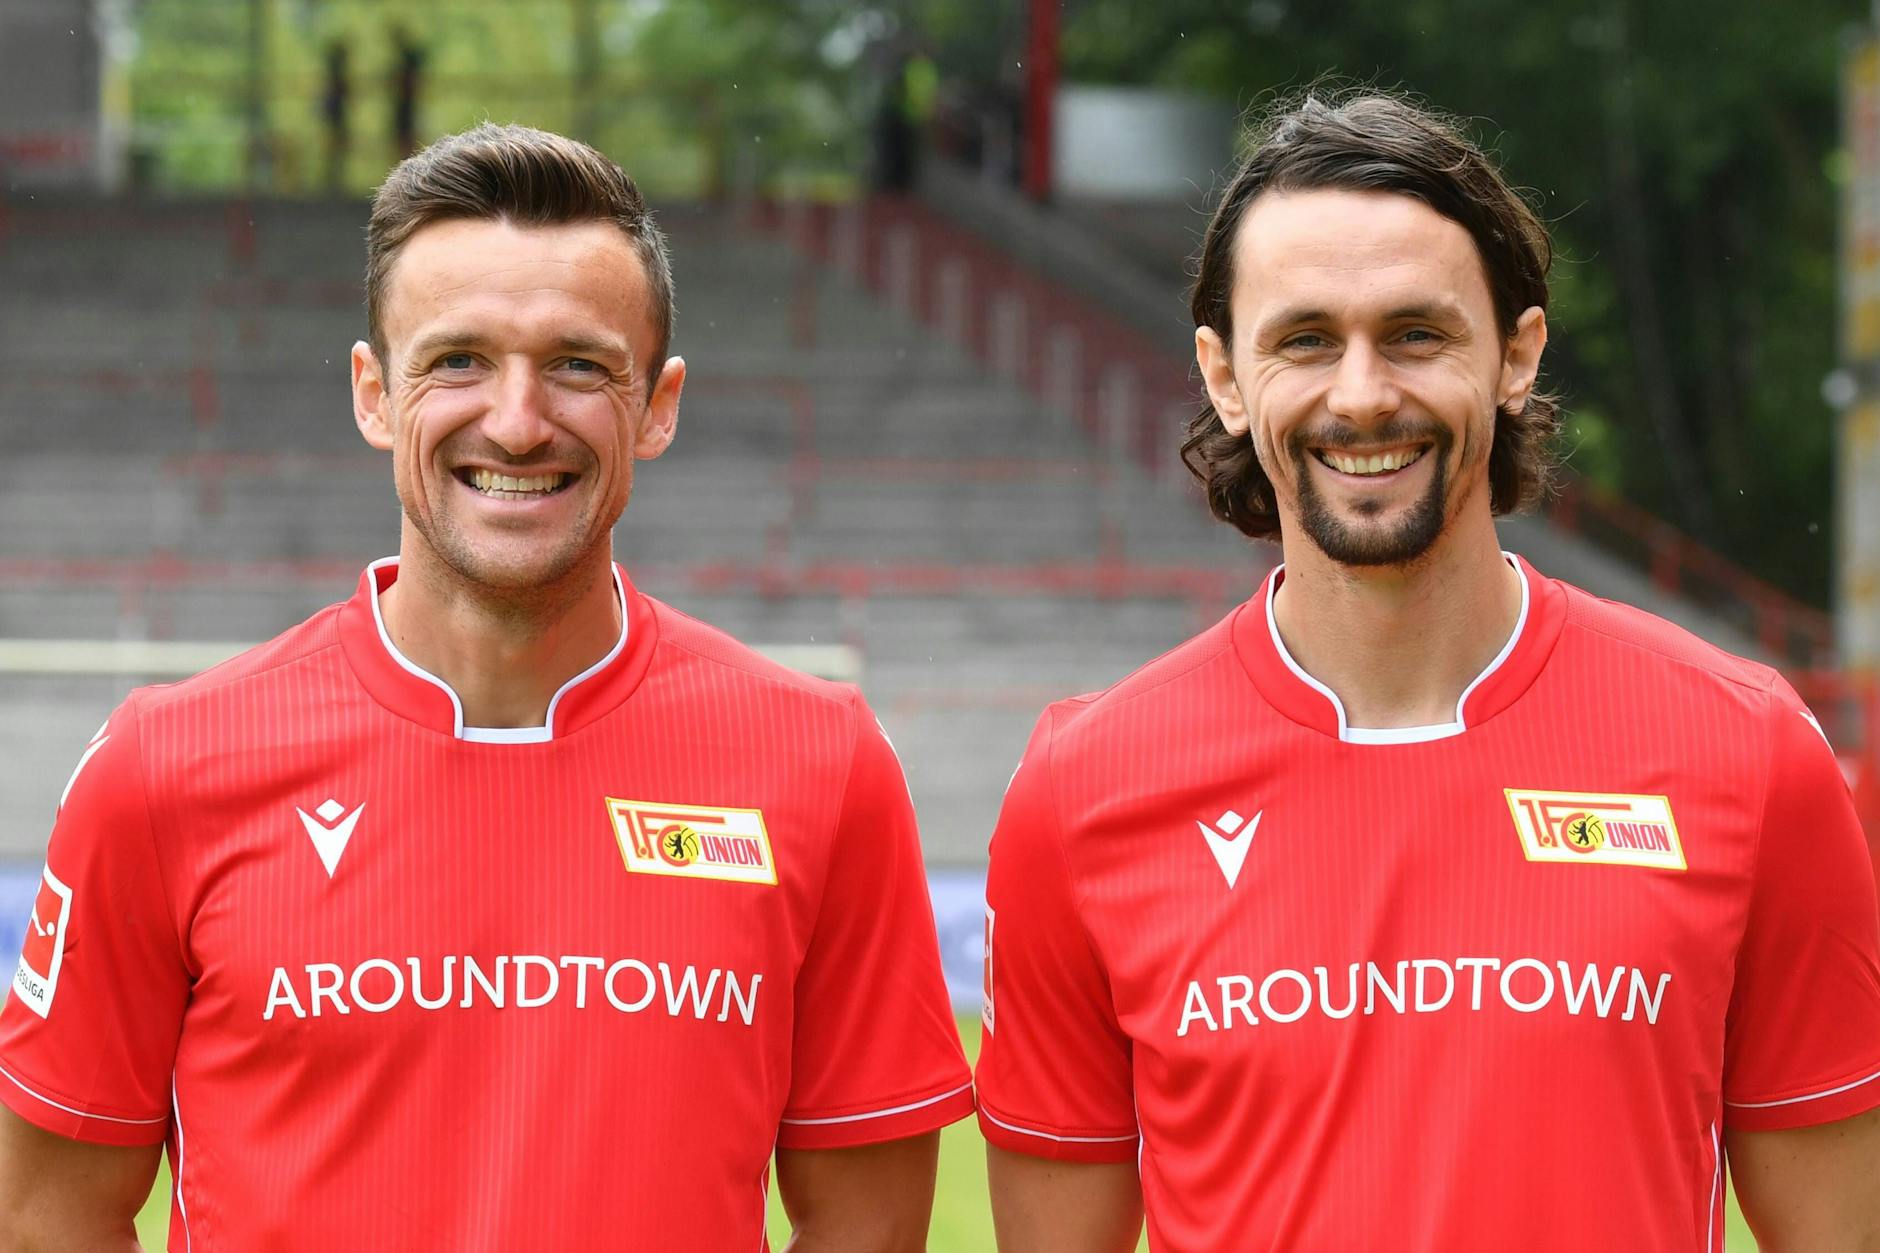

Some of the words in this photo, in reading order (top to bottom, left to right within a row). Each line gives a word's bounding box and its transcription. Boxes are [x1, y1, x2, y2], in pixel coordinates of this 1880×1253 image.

[700, 834, 763, 866] UNION
[1605, 821, 1671, 852] UNION
[17, 965, 44, 1002] ESLIGA
[262, 955, 763, 1025] AROUNDTOWN
[1176, 957, 1672, 1036] AROUNDTOWN
